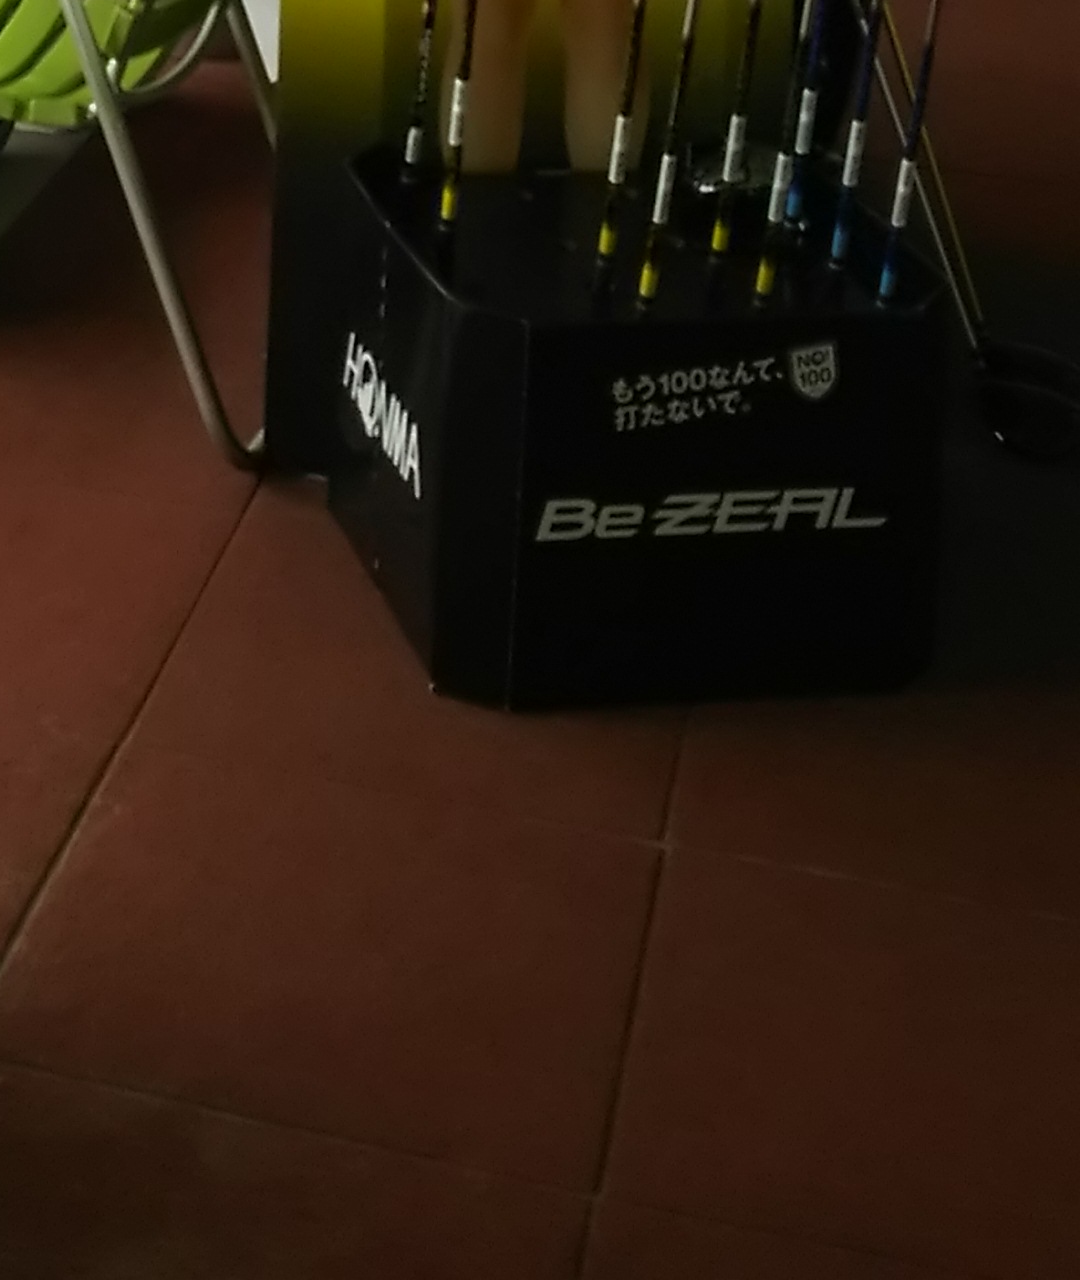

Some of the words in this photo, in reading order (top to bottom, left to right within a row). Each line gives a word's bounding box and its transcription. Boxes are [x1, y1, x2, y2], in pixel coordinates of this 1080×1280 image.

[342, 332, 421, 500] HONMA
[536, 497, 644, 541] Be
[653, 486, 887, 537] ZEAL
